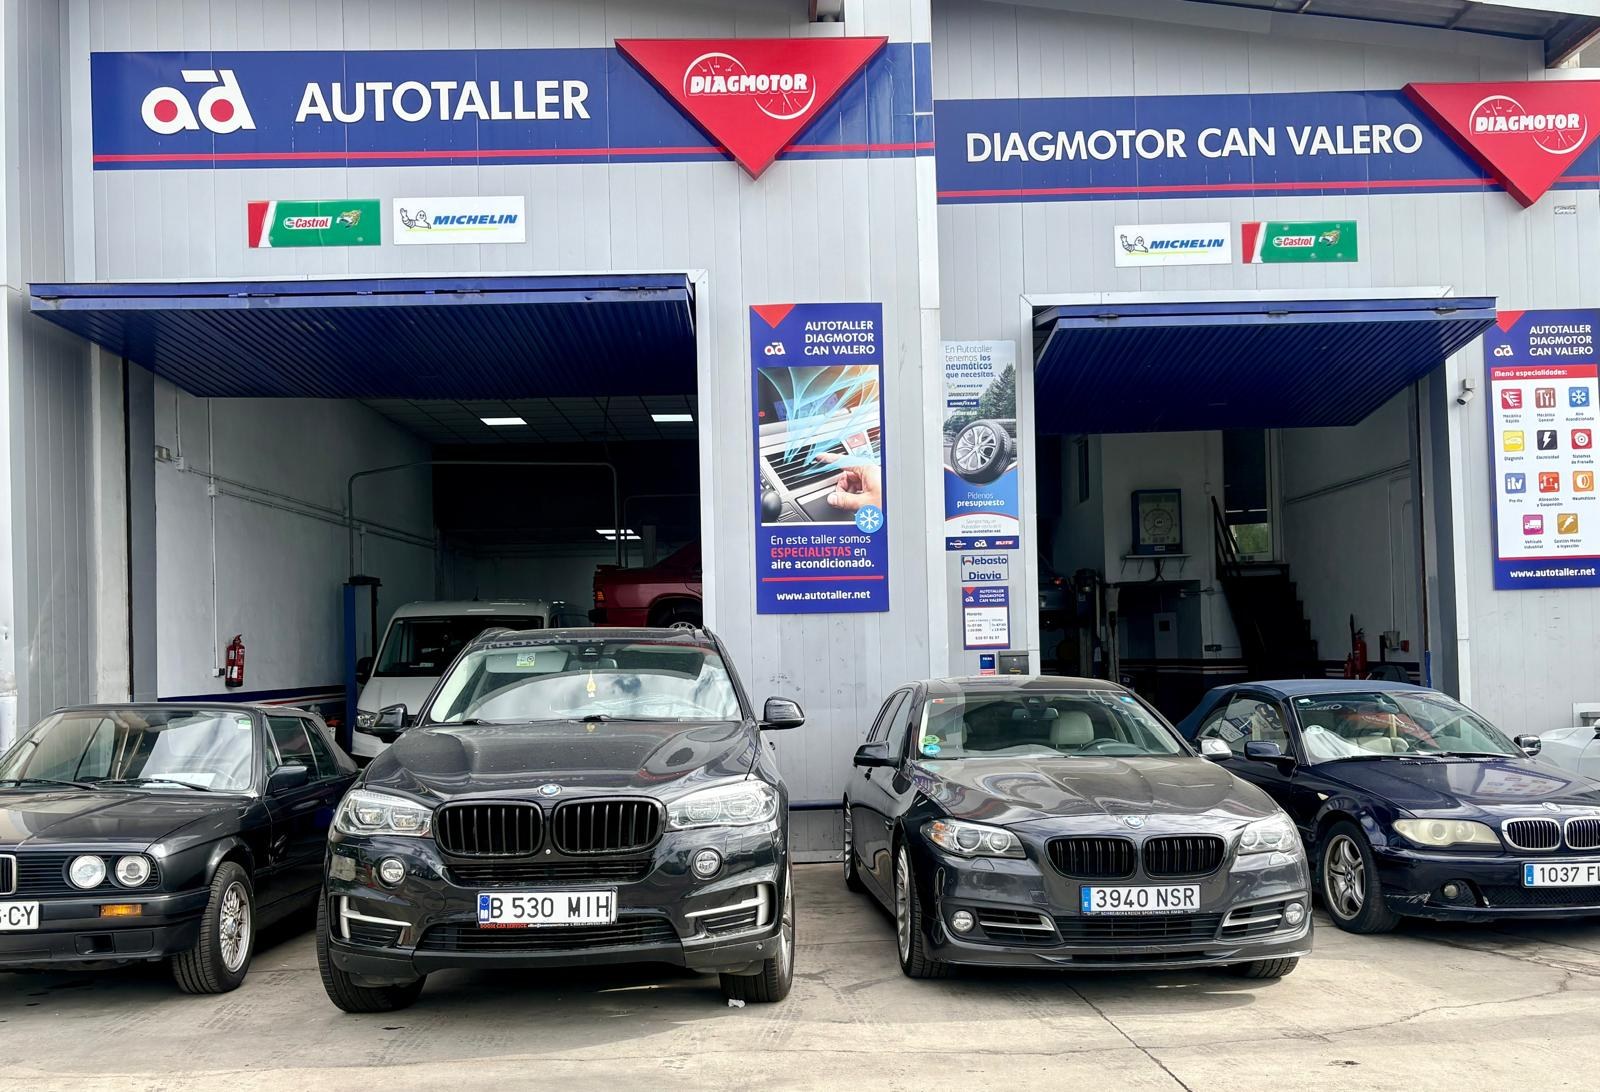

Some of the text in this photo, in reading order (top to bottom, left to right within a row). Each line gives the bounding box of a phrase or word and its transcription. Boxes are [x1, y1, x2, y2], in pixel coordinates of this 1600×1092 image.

[690, 74, 808, 93] DIAGMOTOR
[295, 80, 590, 123] AUTOTALLER
[1475, 114, 1580, 132] DIAGMOTOR
[966, 123, 1423, 164] DIAGMOTOR CAN VALERO
[295, 218, 329, 228] Castrol
[433, 214, 518, 225] MICHELIN
[1150, 238, 1224, 249] MICHELIN
[1283, 237, 1312, 246] Castrol
[804, 320, 874, 331] AUTOTALLER
[1530, 324, 1591, 334] AUTOTALLER
[805, 333, 874, 343] DIAGMOTOR
[1530, 336, 1592, 345] DIAGMOTOR
[804, 345, 875, 355] CAN VALERO
[945, 345, 992, 353] En Autotaller
[1530, 346, 1593, 356] CAN VALERO
[946, 362, 992, 370] neumáticos
[957, 500, 1005, 508] presupuesto
[770, 536, 783, 545] En
[786, 536, 808, 544] este
[811, 535, 836, 544] taller
[770, 547, 867, 558] ESPECIALISTAS en
[771, 558, 874, 569] aire acondicionado.
[962, 556, 1007, 566] Webasto
[969, 571, 1002, 580] Diavia
[1510, 568, 1596, 578] www.autotaller.net
[776, 590, 871, 600] www.autotaller.net
[1540, 867, 1579, 882] 1037
[1096, 888, 1195, 908] 3940 NSR
[491, 898, 503, 918] B
[512, 897, 553, 918] 530
[568, 896, 609, 918] MIH
